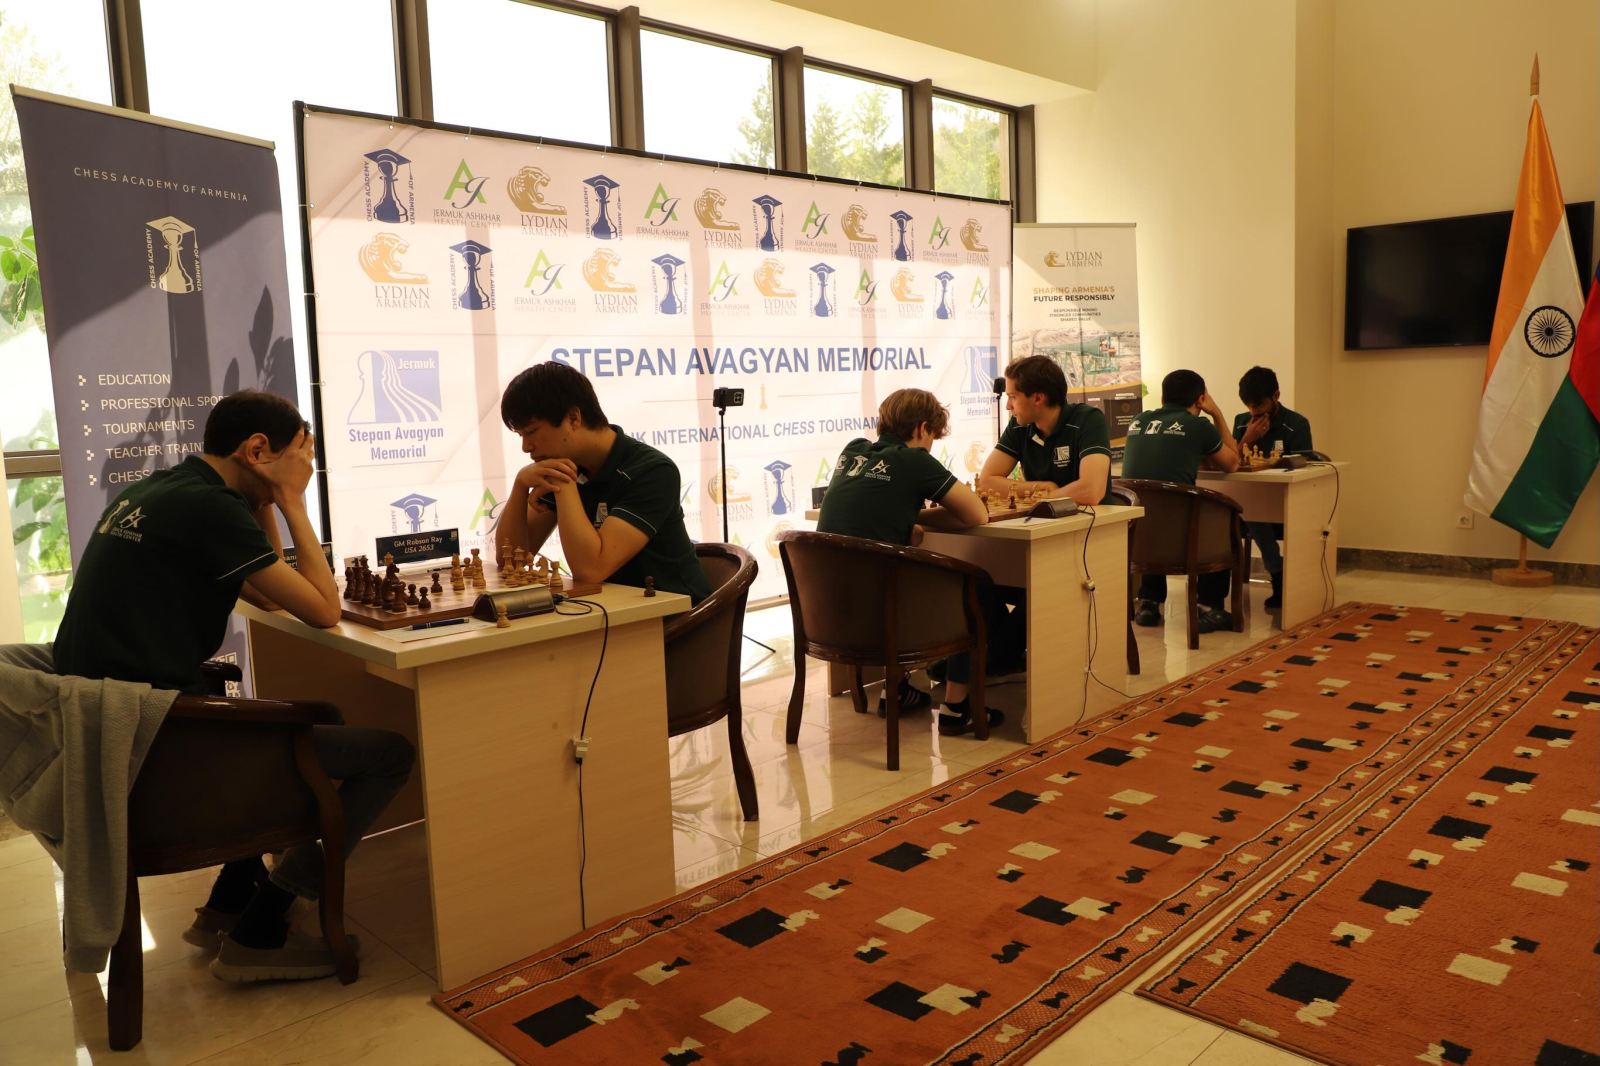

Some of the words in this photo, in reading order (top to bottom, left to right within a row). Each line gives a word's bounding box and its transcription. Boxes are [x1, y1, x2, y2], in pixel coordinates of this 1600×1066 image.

[74, 167, 117, 182] CHESS
[122, 174, 179, 191] ACADEMY
[183, 184, 197, 194] OF
[201, 187, 248, 203] ARMENIA
[363, 161, 372, 197] ACADEMY
[408, 191, 416, 225] ARMENIA
[433, 208, 463, 219] JERMUK
[466, 211, 501, 222] ASHKHAR
[520, 214, 568, 230] LYDIAN
[704, 230, 742, 243] LYDIAN
[145, 228, 154, 264] ACADEMY
[849, 242, 879, 253] LYDIAN
[1065, 251, 1103, 261] LYDIAN
[194, 259, 203, 292] ARMENIA
[374, 285, 430, 300] LYDIAN
[1033, 286, 1070, 295] SHAPING
[375, 299, 431, 309] ARMENIA
[594, 293, 638, 306] LYDIAN
[764, 298, 798, 310] LYDIAN
[1033, 295, 1063, 303] FUTURE
[1065, 294, 1115, 302] RESPONSIBLY
[398, 357, 436, 370] Jermuk
[551, 347, 676, 377] STEPAN
[685, 347, 809, 375] AVAGYAN
[817, 346, 932, 373] MEMORIAL
[98, 373, 171, 386] EDUCATION
[100, 396, 194, 411] PROFESSIONAL
[103, 419, 195, 435] TOURNAMENTS
[652, 424, 769, 446] INTERNATIONAL
[773, 420, 815, 437] CHESS
[818, 416, 880, 433] TOURNAM
[348, 428, 391, 444] Stepan
[395, 426, 444, 442] Avagyan
[105, 444, 163, 460] TEACHER
[166, 441, 204, 455] TRAIN
[370, 444, 427, 461] Memorial
[108, 469, 151, 484] CHESS
[393, 540, 405, 548] GM
[406, 537, 430, 546] Robson
[431, 536, 443, 544] Ray
[404, 546, 417, 554] USA
[418, 543, 435, 553] 2653
